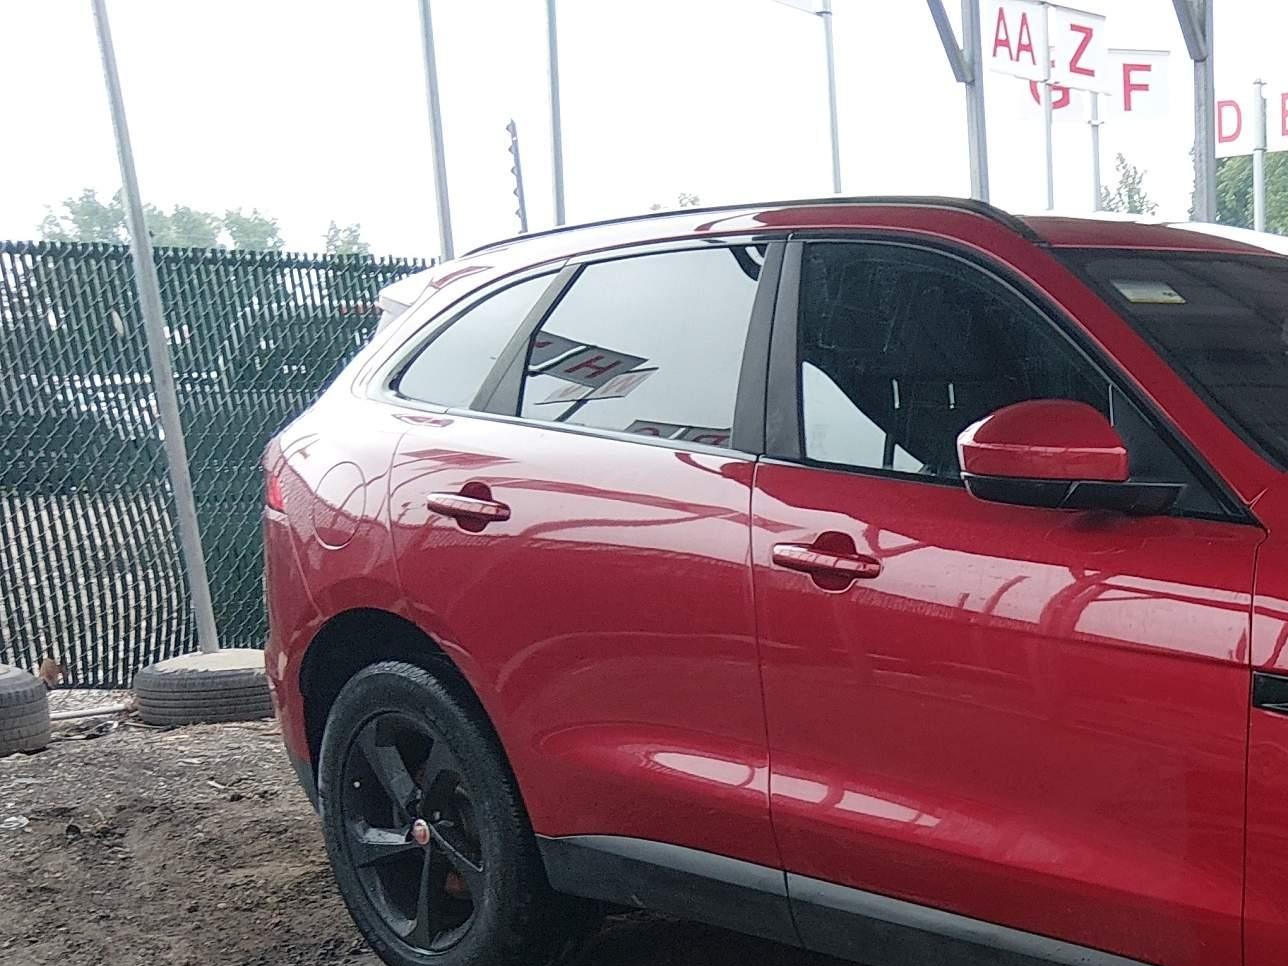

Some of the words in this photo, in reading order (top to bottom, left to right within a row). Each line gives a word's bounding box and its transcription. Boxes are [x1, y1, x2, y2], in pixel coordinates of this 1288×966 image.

[992, 7, 1036, 65] AA
[1068, 23, 1096, 77] Z
[1122, 63, 1153, 112] F
[1216, 99, 1243, 144] D
